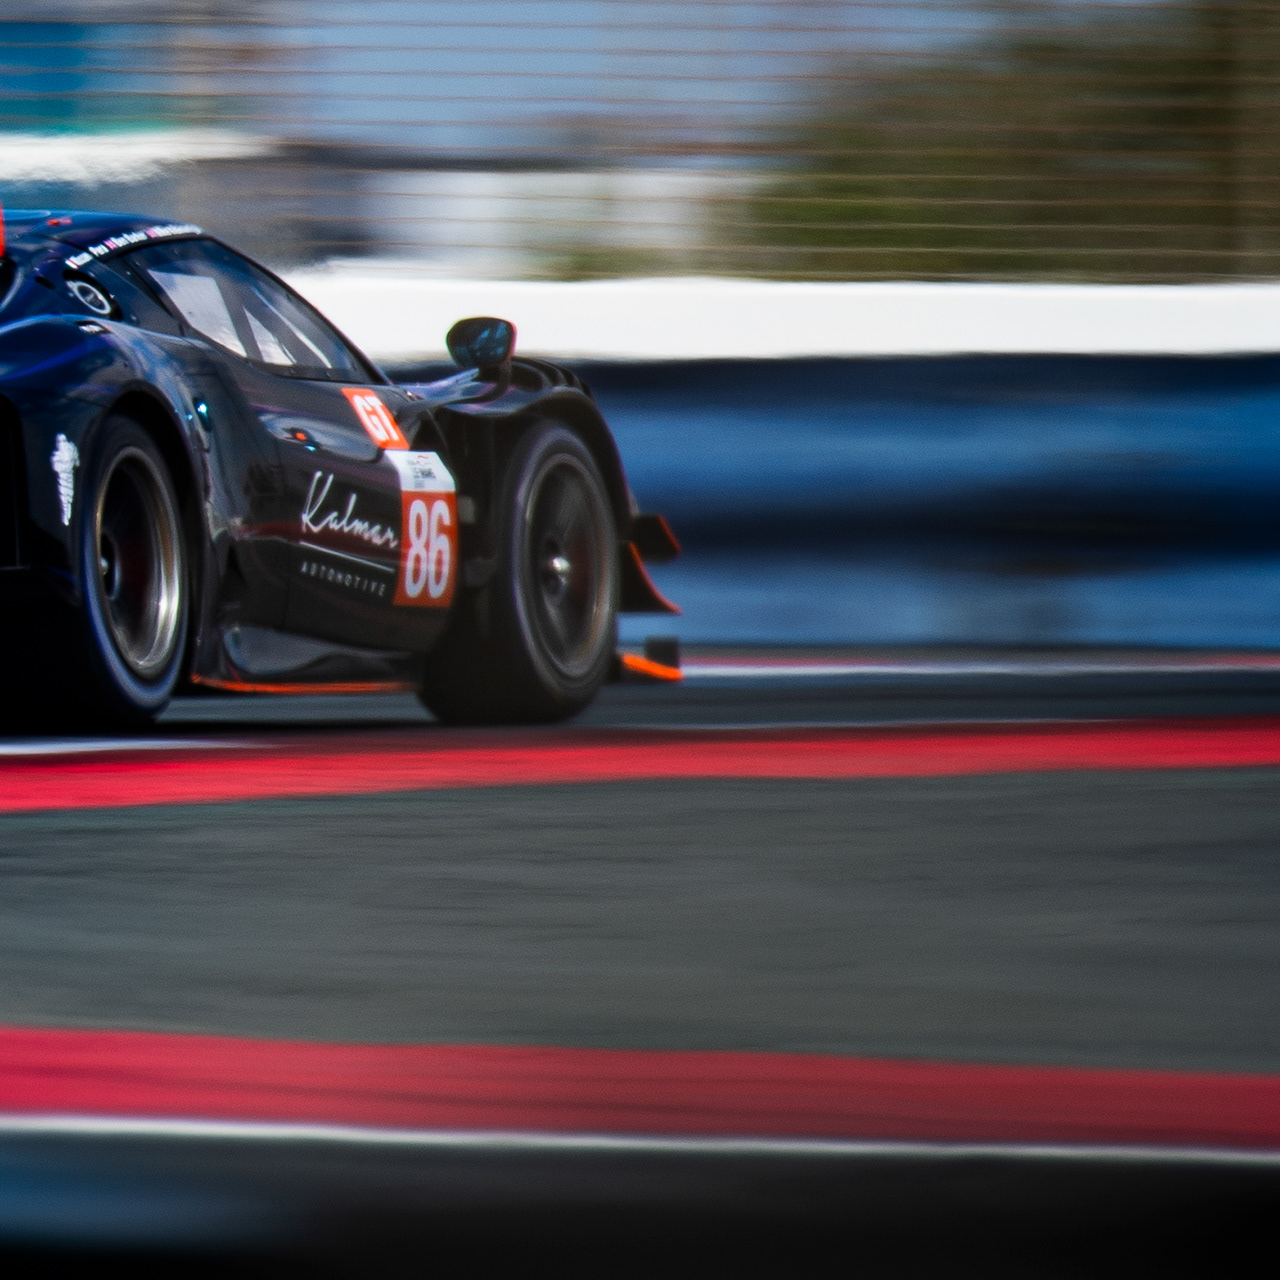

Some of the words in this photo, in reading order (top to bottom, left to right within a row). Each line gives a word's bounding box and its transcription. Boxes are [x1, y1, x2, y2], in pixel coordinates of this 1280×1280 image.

[352, 394, 400, 441] GT
[301, 470, 398, 549] Kalmar
[301, 561, 386, 596] AUTOMOTIVE
[404, 499, 451, 598] 86
